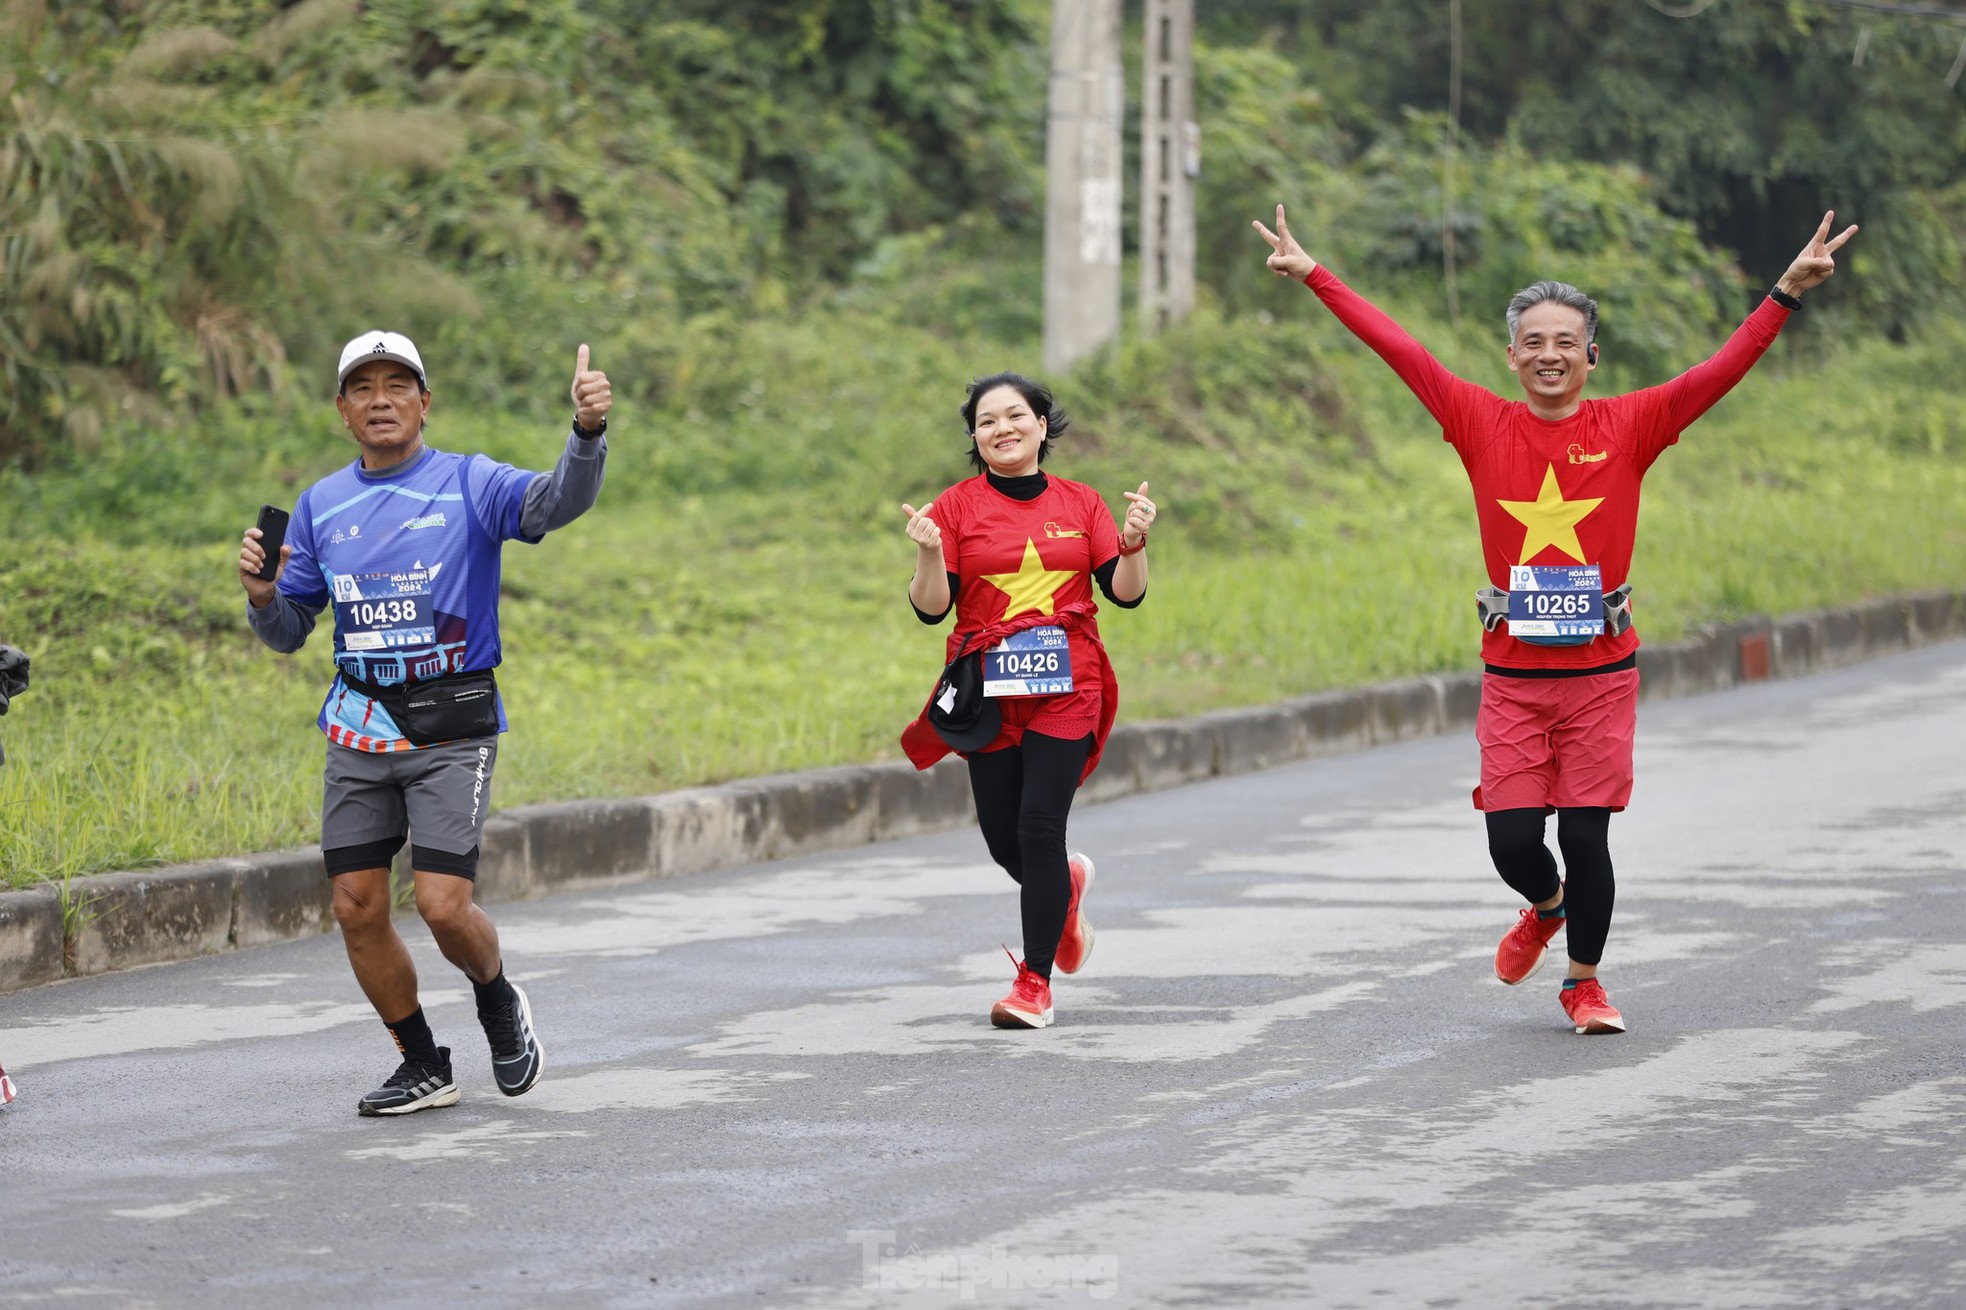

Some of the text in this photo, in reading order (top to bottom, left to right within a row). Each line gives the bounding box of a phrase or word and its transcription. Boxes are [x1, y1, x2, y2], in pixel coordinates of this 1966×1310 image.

[338, 580, 353, 593] 10
[1514, 571, 1530, 582] 10
[350, 600, 417, 626] 10438
[1524, 594, 1590, 614] 10265
[996, 652, 1059, 674] 10426
